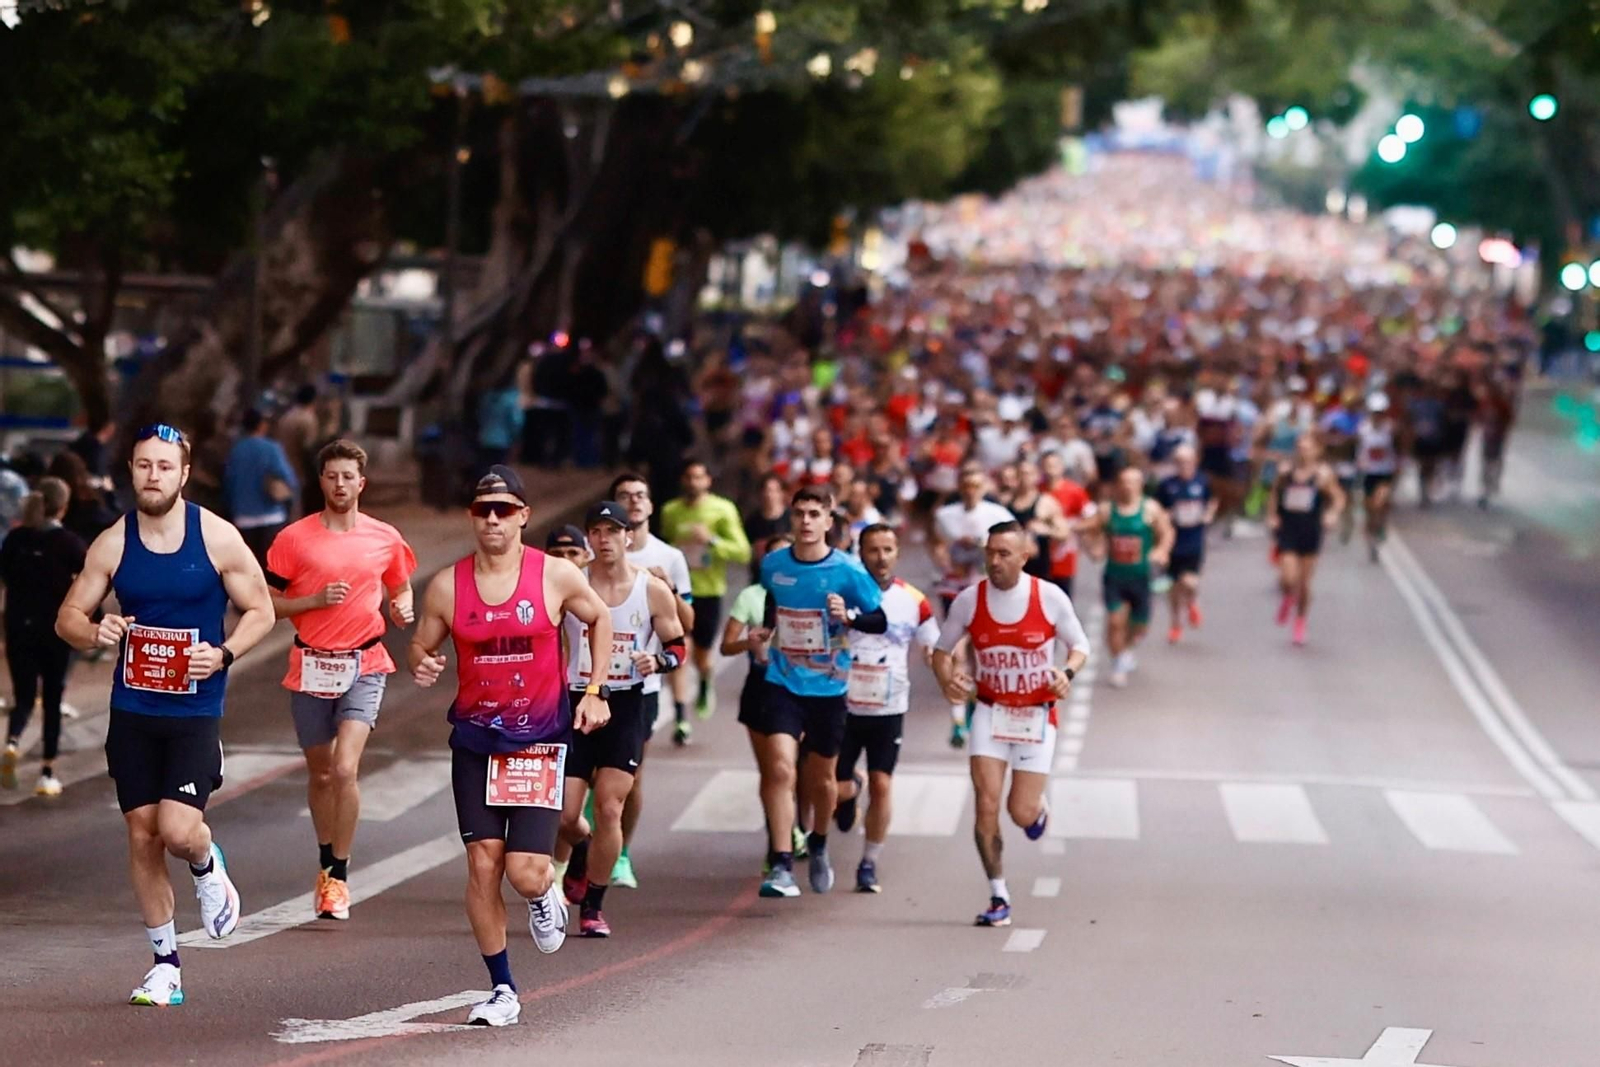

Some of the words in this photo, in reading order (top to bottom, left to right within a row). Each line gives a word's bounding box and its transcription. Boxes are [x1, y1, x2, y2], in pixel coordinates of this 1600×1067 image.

[143, 630, 187, 641] GENERALI
[141, 643, 176, 658] 4686
[314, 660, 346, 672] 18299
[506, 757, 542, 771] 3598
